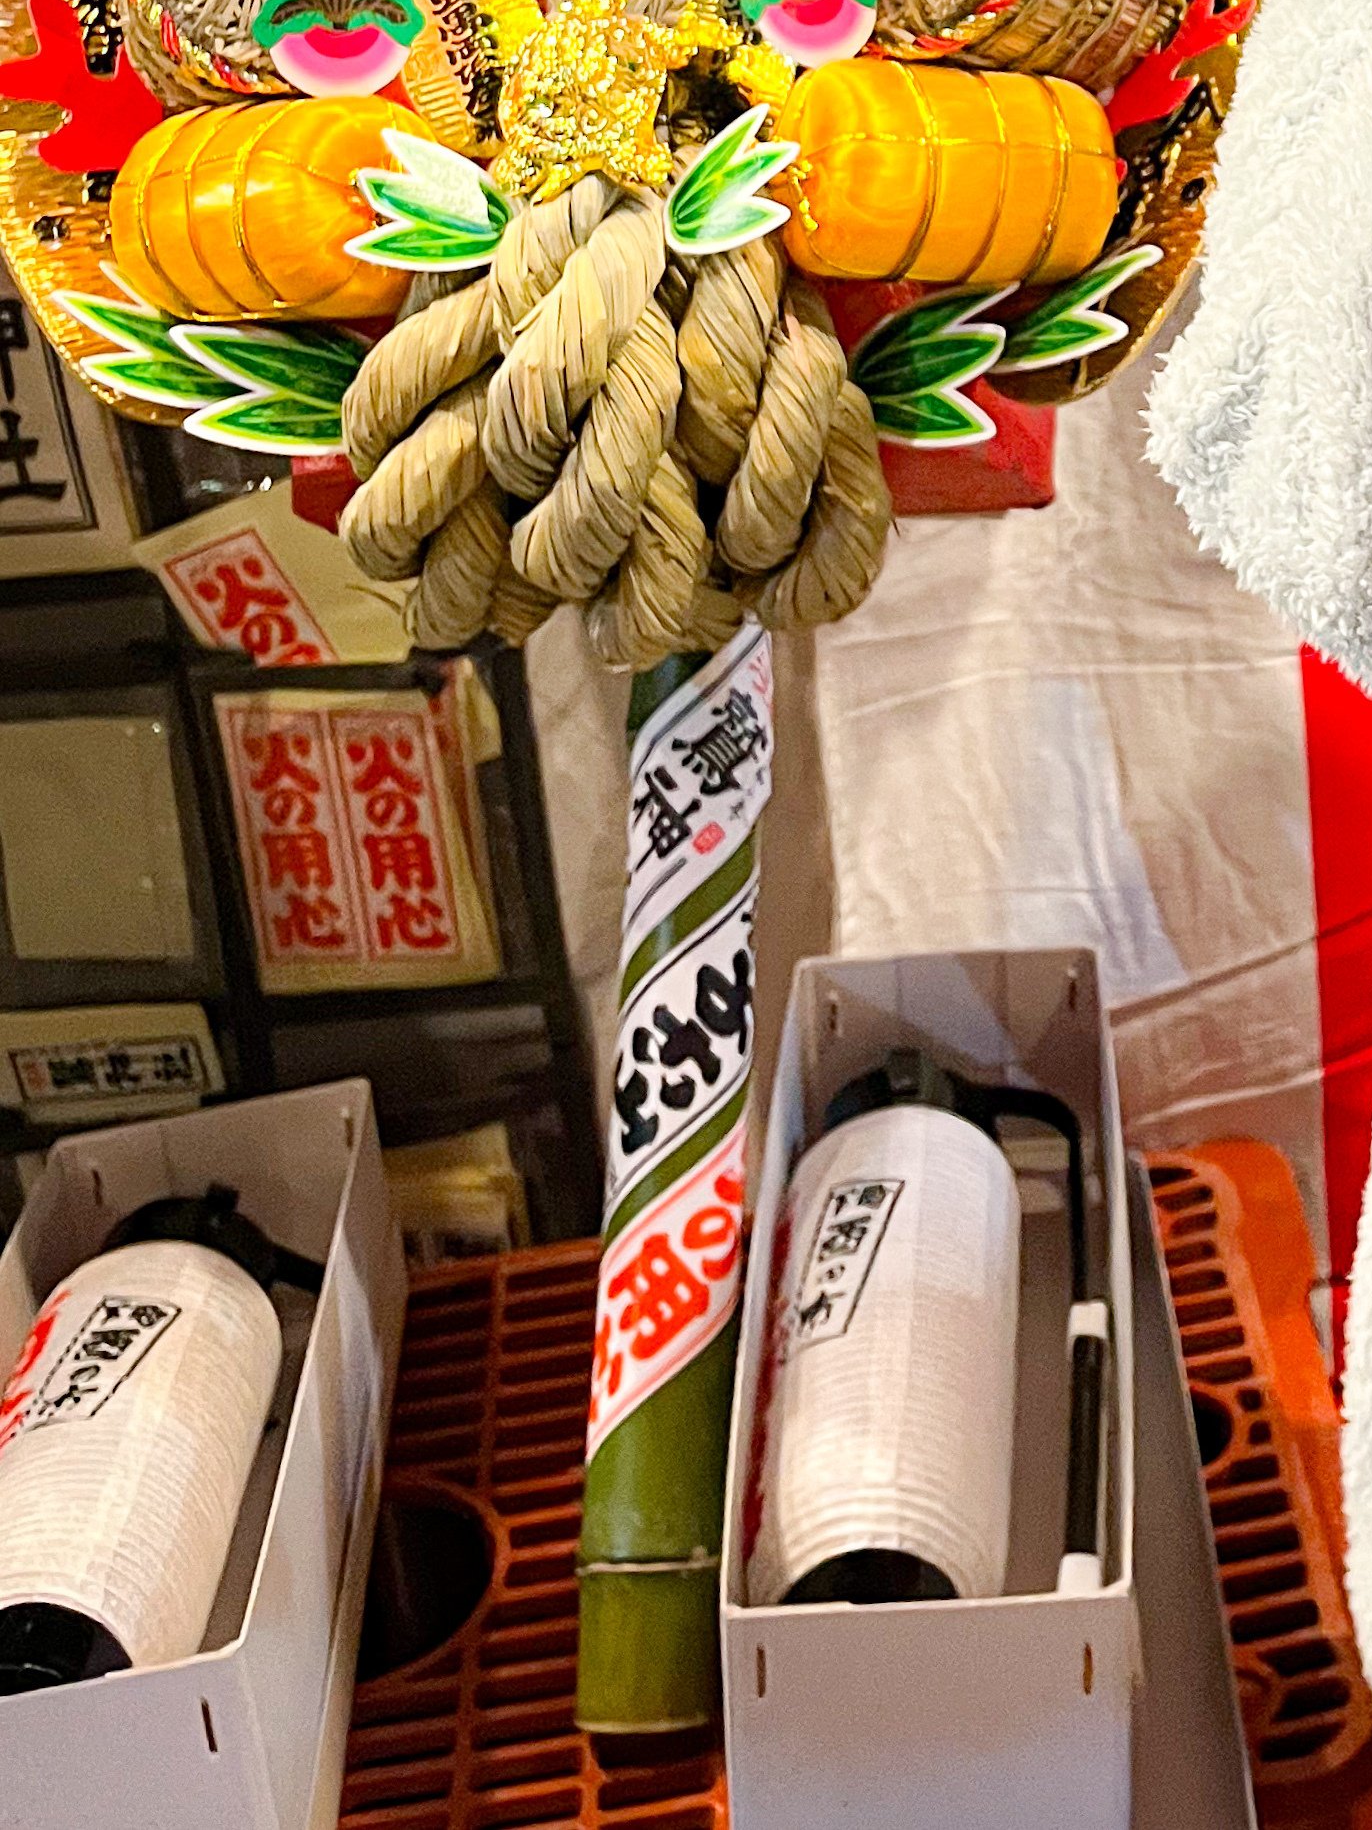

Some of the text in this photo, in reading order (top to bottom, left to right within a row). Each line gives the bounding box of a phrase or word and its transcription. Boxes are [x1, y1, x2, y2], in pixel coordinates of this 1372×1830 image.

[243, 731, 346, 949] 火の用心
[346, 733, 451, 950] 火の用心
